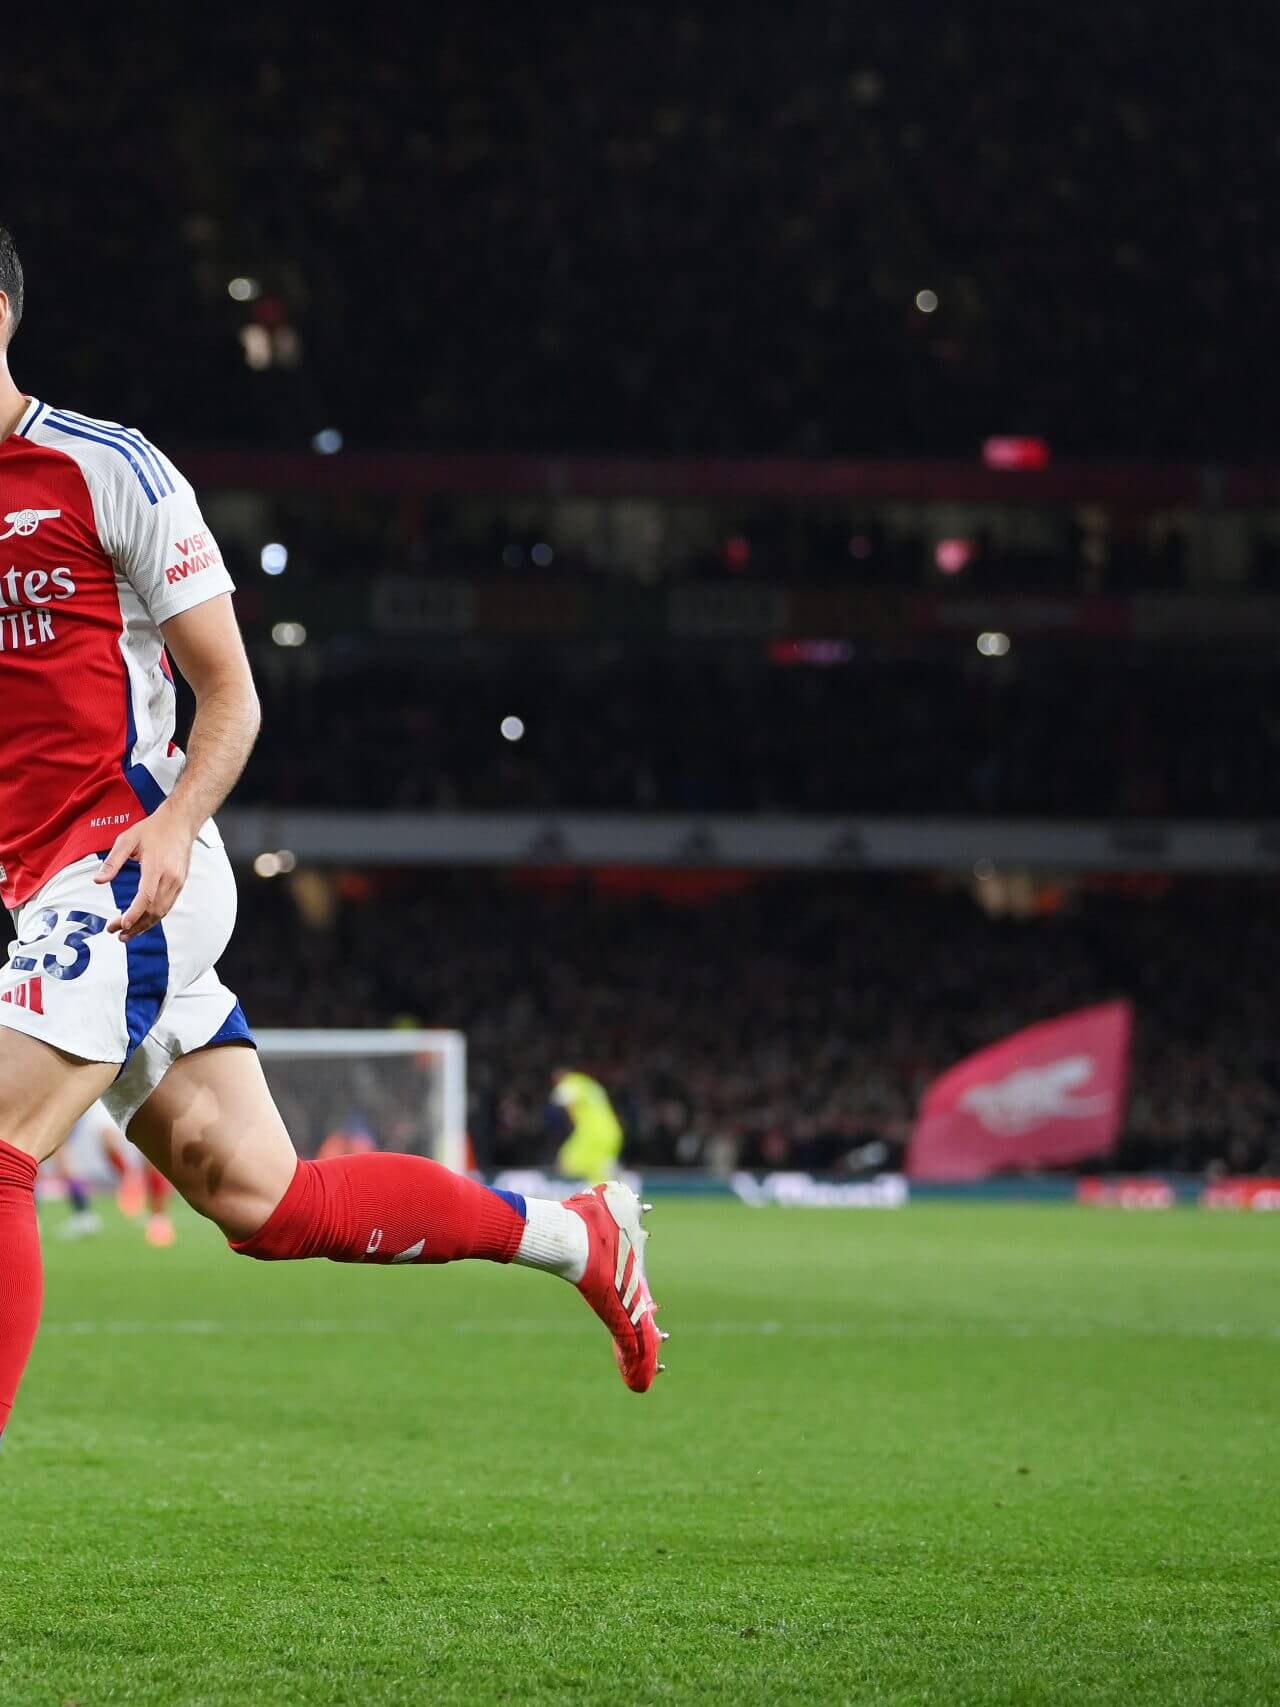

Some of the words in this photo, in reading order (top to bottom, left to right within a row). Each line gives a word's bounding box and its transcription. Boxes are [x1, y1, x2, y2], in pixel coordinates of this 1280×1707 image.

[175, 531, 207, 556] VISIT
[165, 549, 217, 585] RWAN
[9, 908, 108, 981] 23
